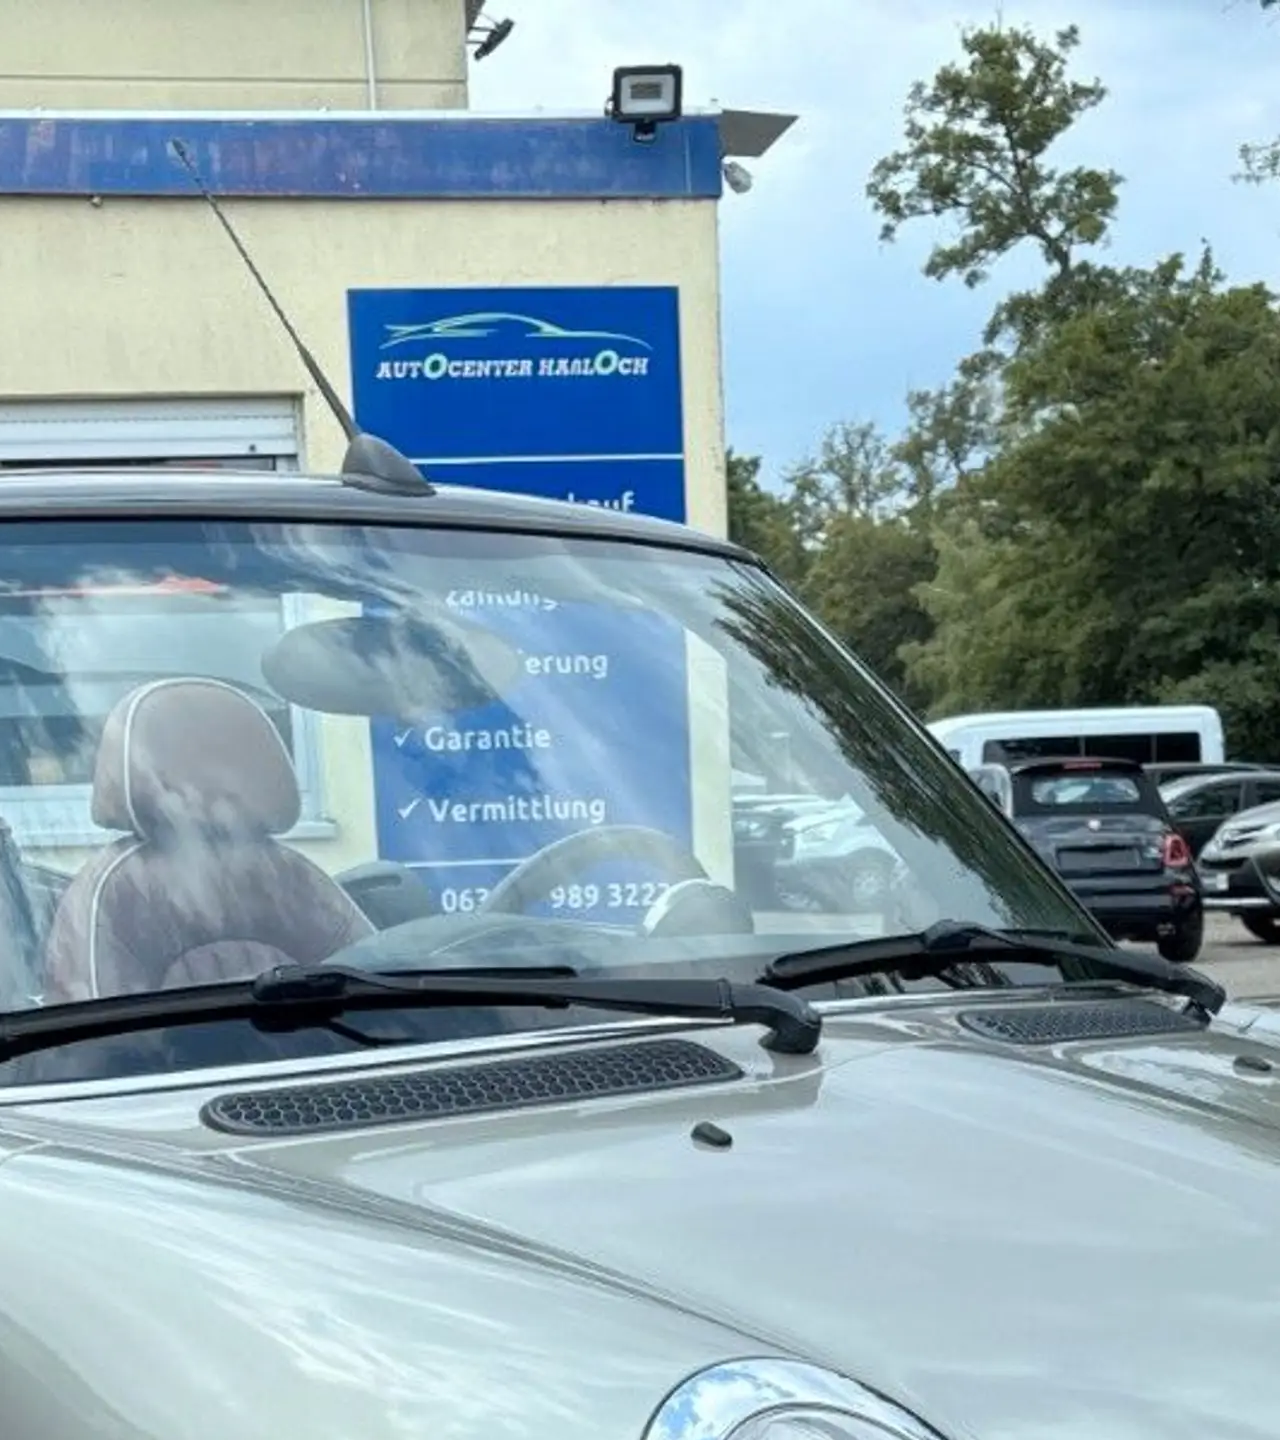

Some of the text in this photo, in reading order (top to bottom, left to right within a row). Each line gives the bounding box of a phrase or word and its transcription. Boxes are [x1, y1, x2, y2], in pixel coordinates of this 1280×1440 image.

[376, 353, 533, 379] AUTOCENTER
[424, 721, 551, 750] Garantie
[426, 795, 606, 823] Vermittlung
[550, 884, 599, 908] 989
